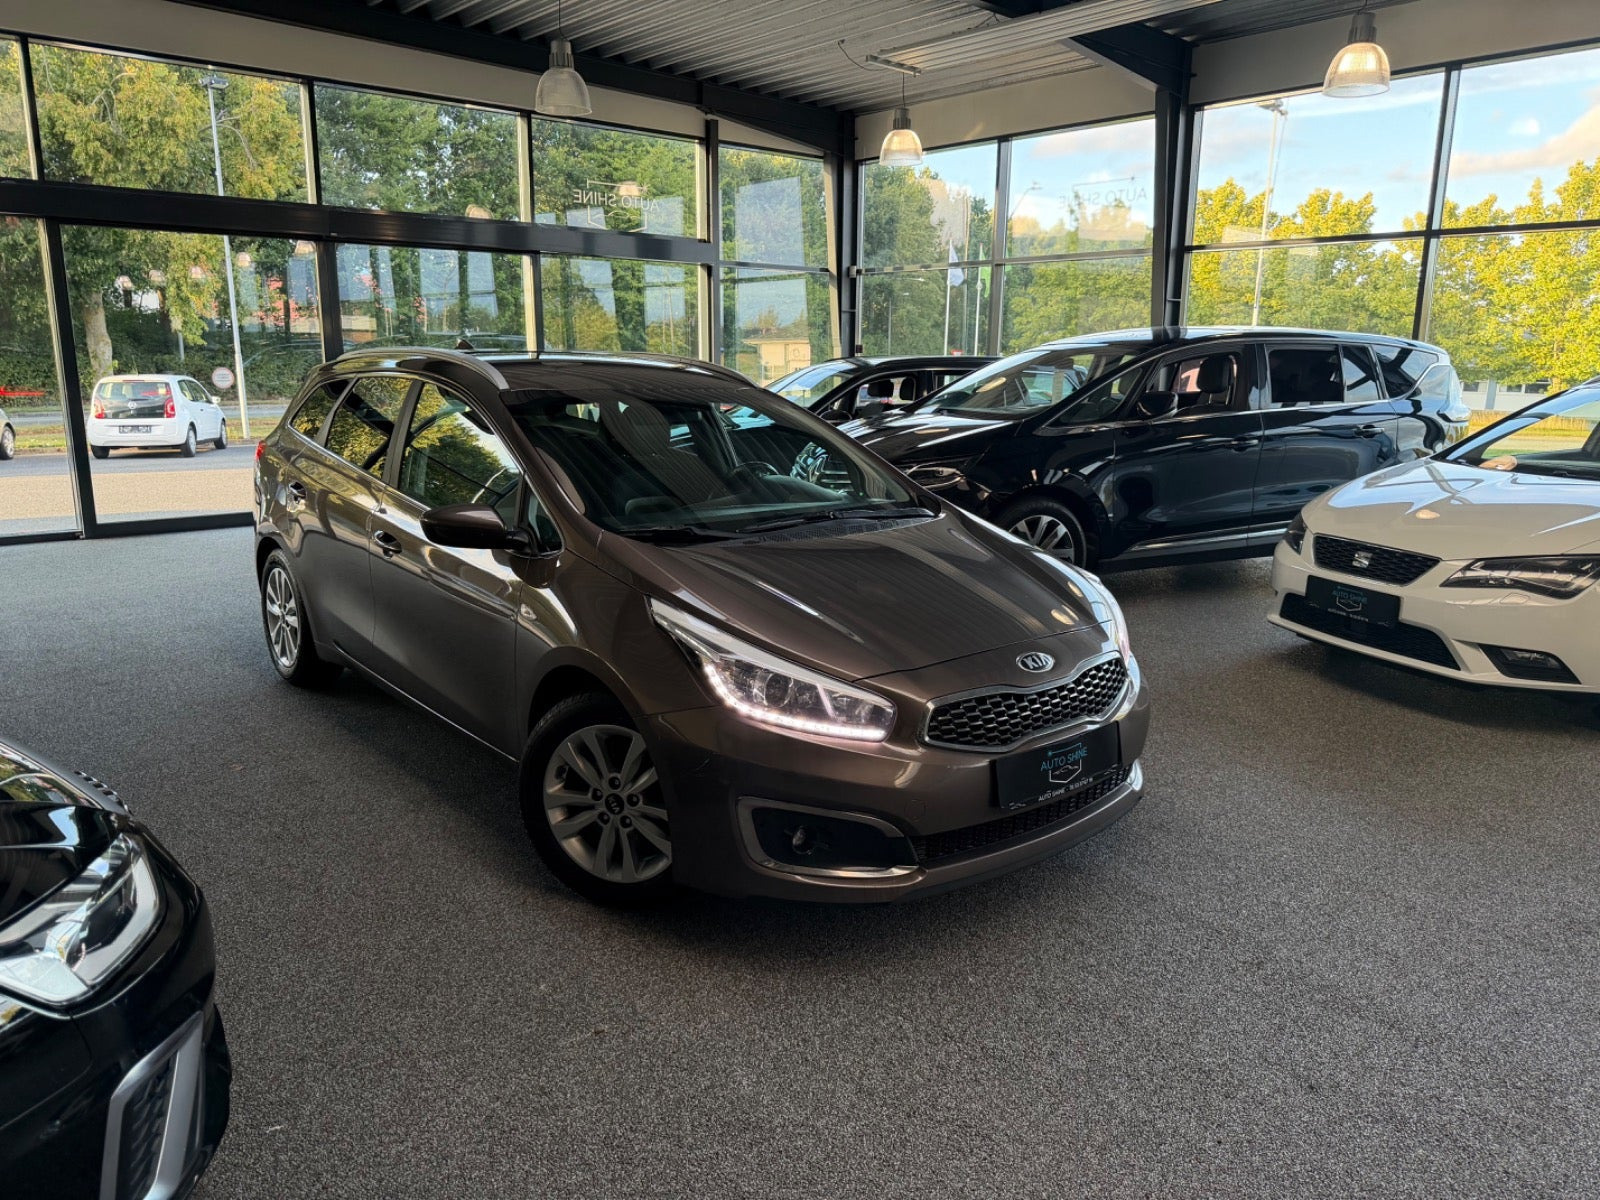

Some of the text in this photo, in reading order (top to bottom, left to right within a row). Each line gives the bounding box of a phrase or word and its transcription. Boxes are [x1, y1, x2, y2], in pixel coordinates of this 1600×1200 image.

[1022, 655, 1051, 670] KIA
[1040, 746, 1088, 772] AUTO SHINE
